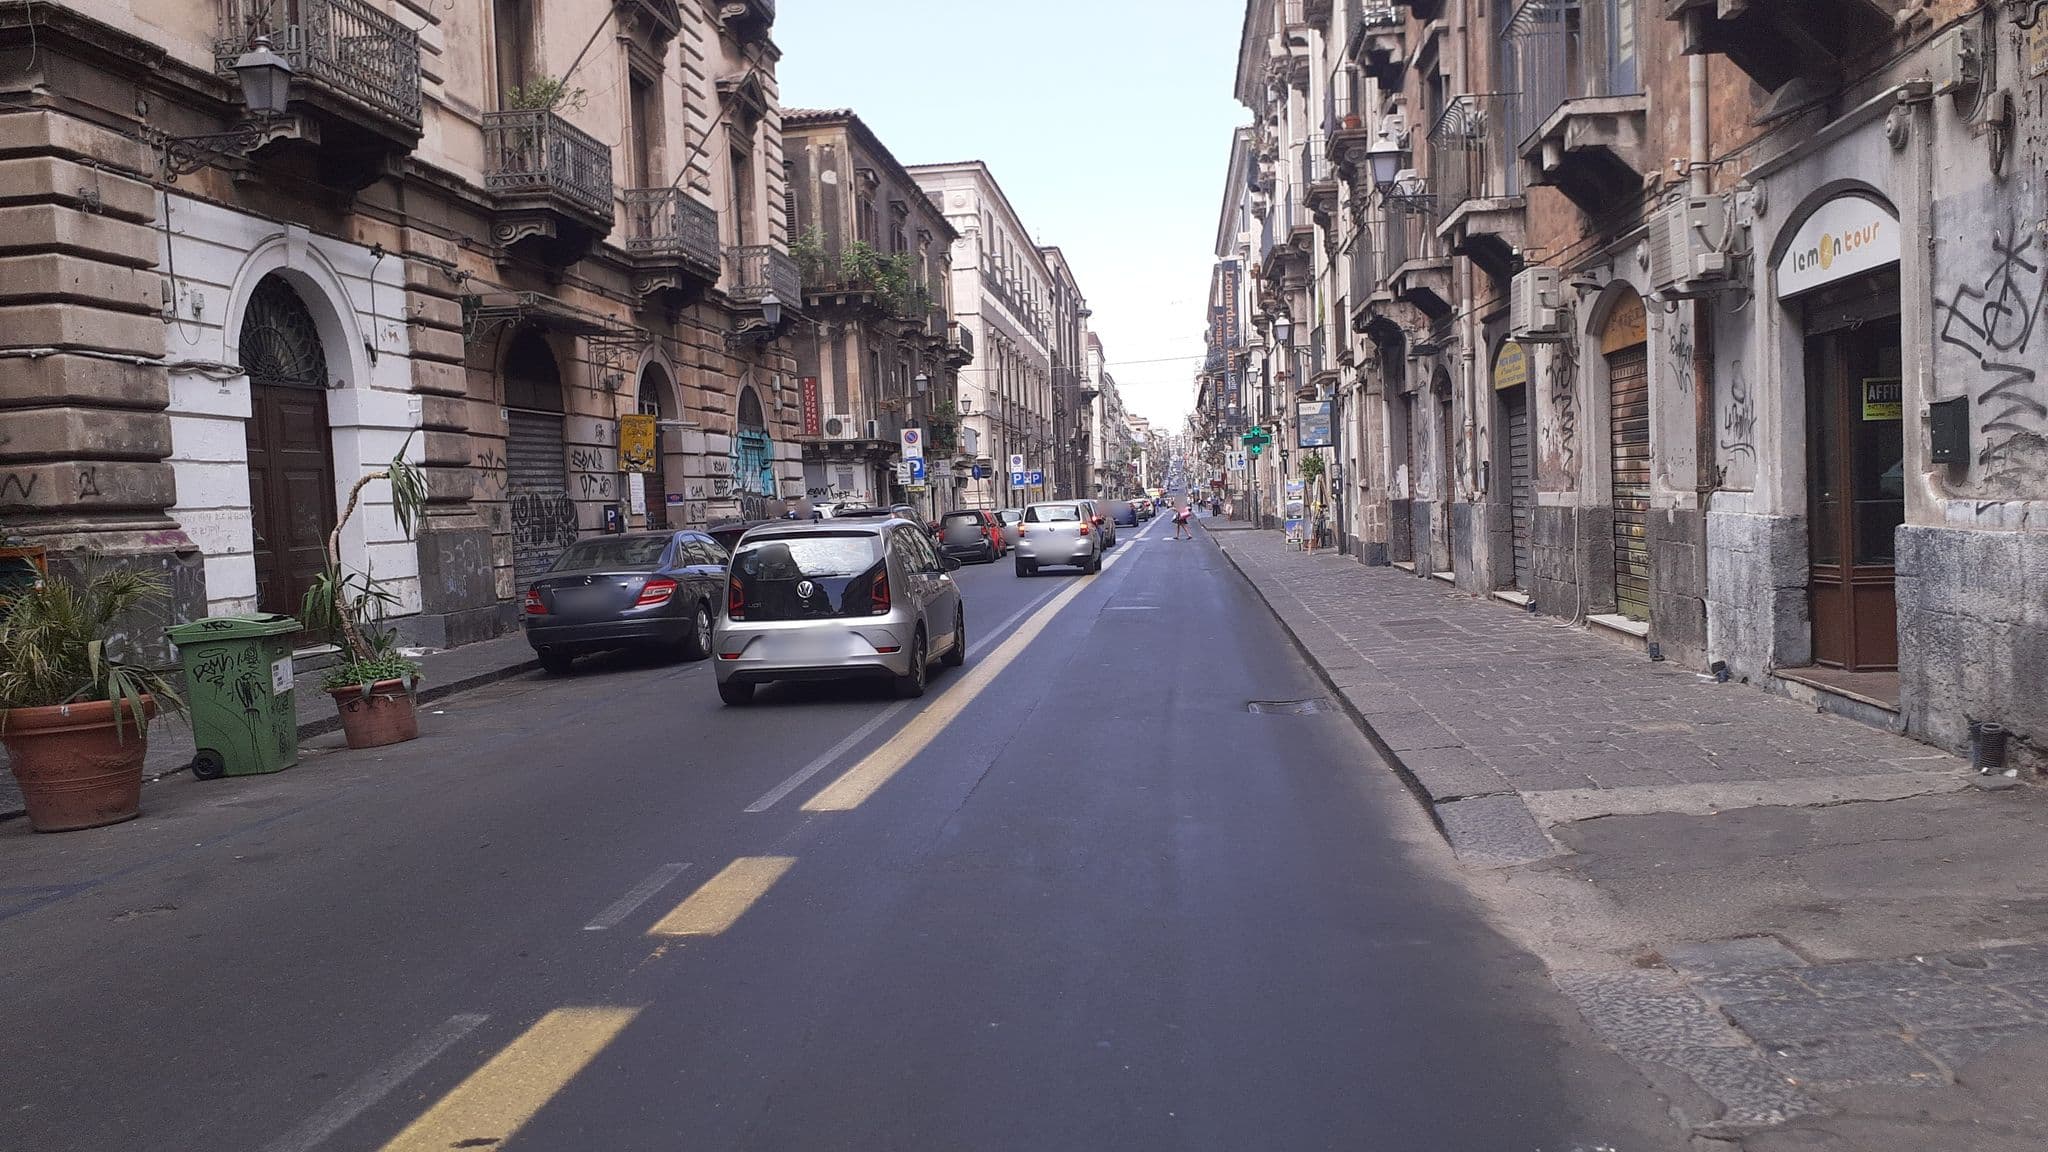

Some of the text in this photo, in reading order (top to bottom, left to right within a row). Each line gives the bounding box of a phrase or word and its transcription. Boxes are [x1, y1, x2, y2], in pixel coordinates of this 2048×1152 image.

[1793, 221, 1880, 273] lemon tour
[1225, 270, 1235, 325] Leonardo
[1013, 473, 1022, 484] P
[1032, 473, 1040, 483] P
[607, 509, 616, 522] P
